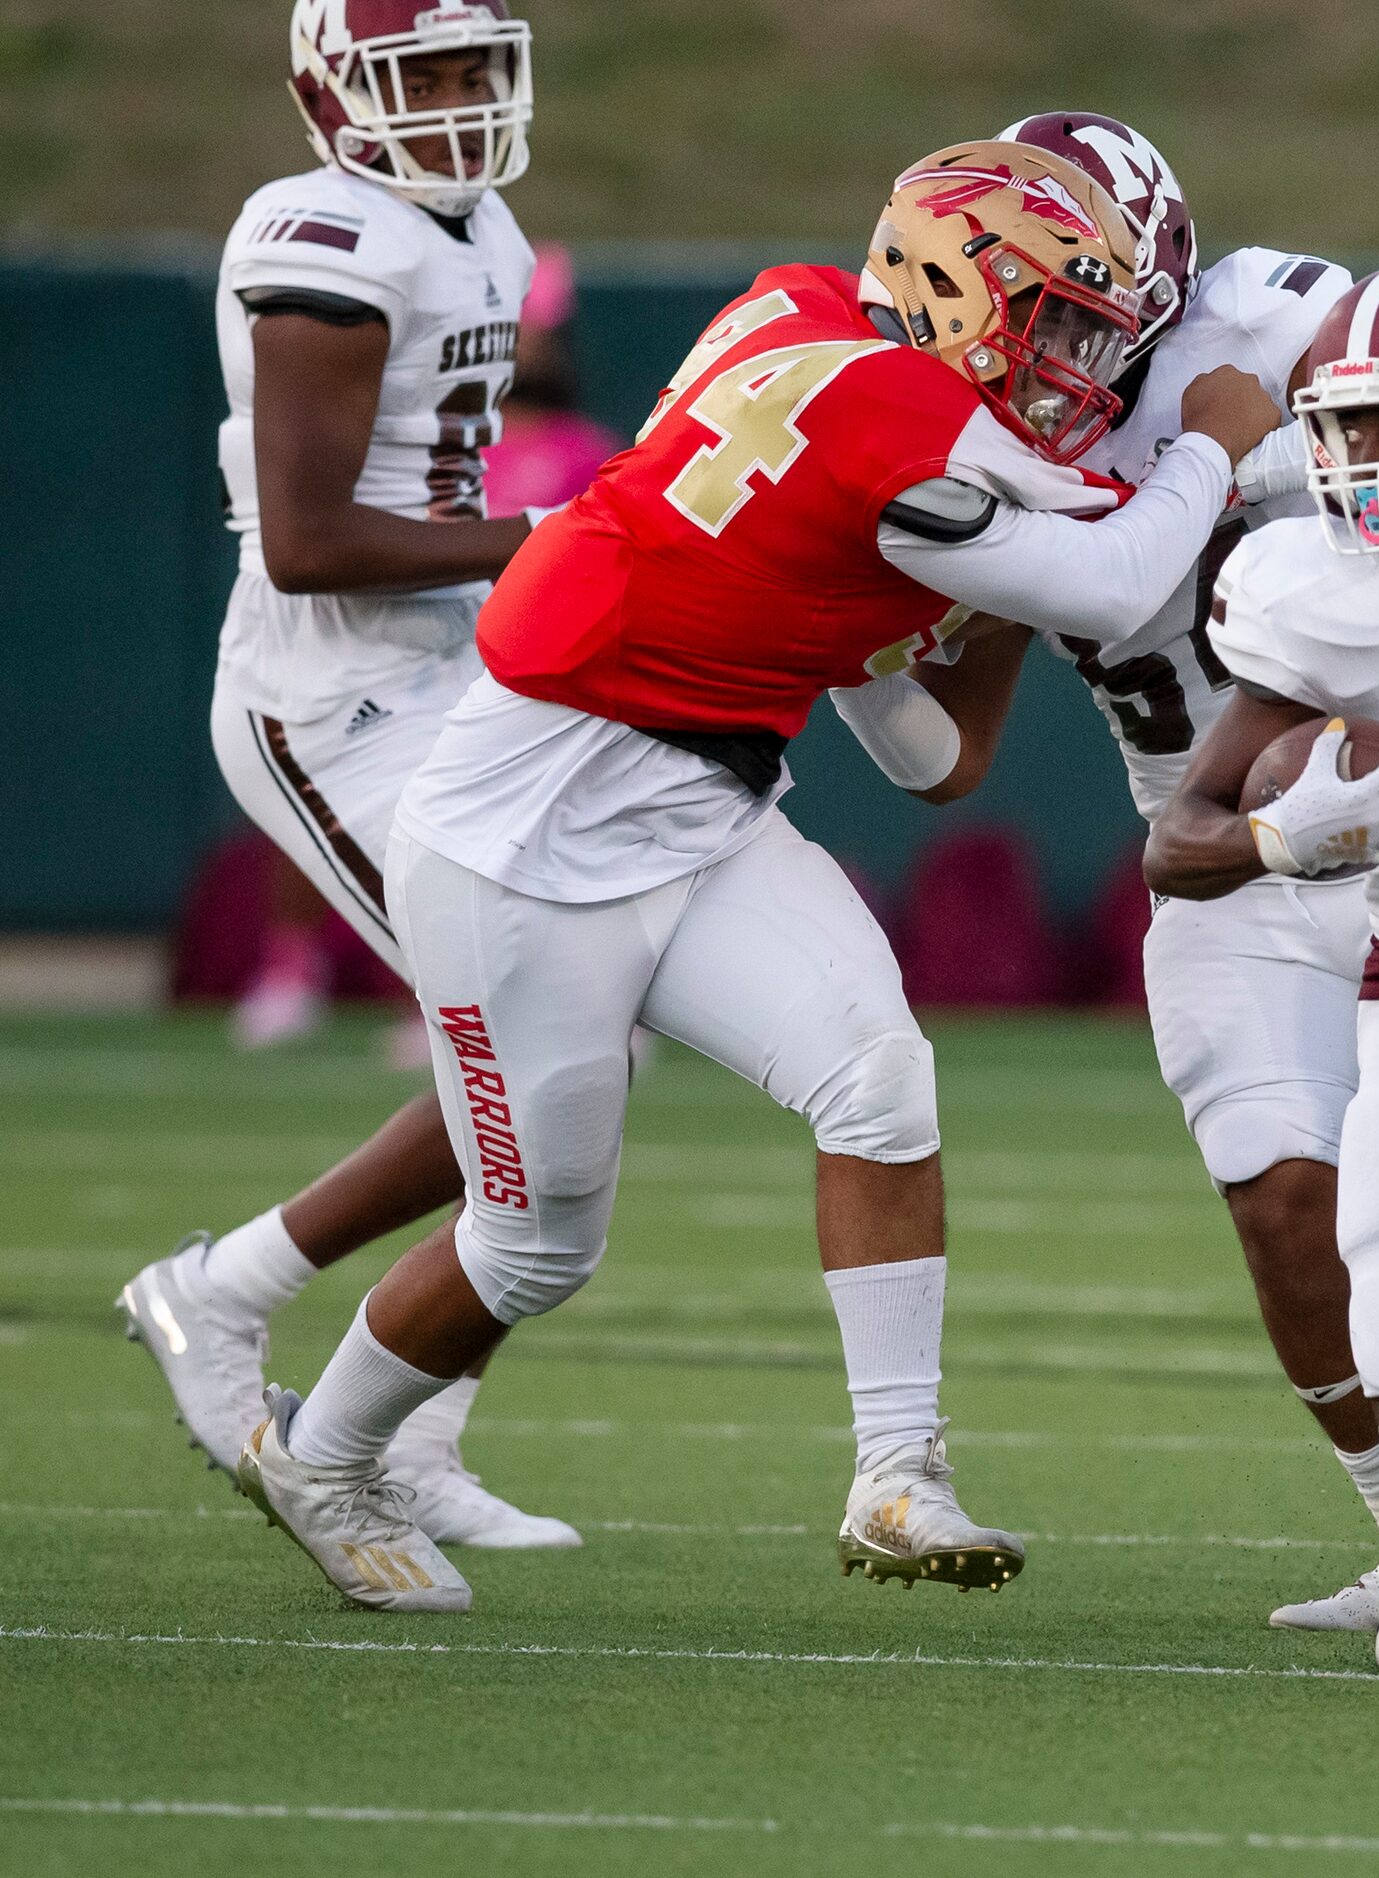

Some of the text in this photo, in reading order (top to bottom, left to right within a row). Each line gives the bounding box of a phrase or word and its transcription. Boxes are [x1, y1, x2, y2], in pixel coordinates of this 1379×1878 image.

[1070, 125, 1182, 204] M
[1332, 361, 1373, 377] Riddell
[438, 1003, 529, 1210] WARRIORS
